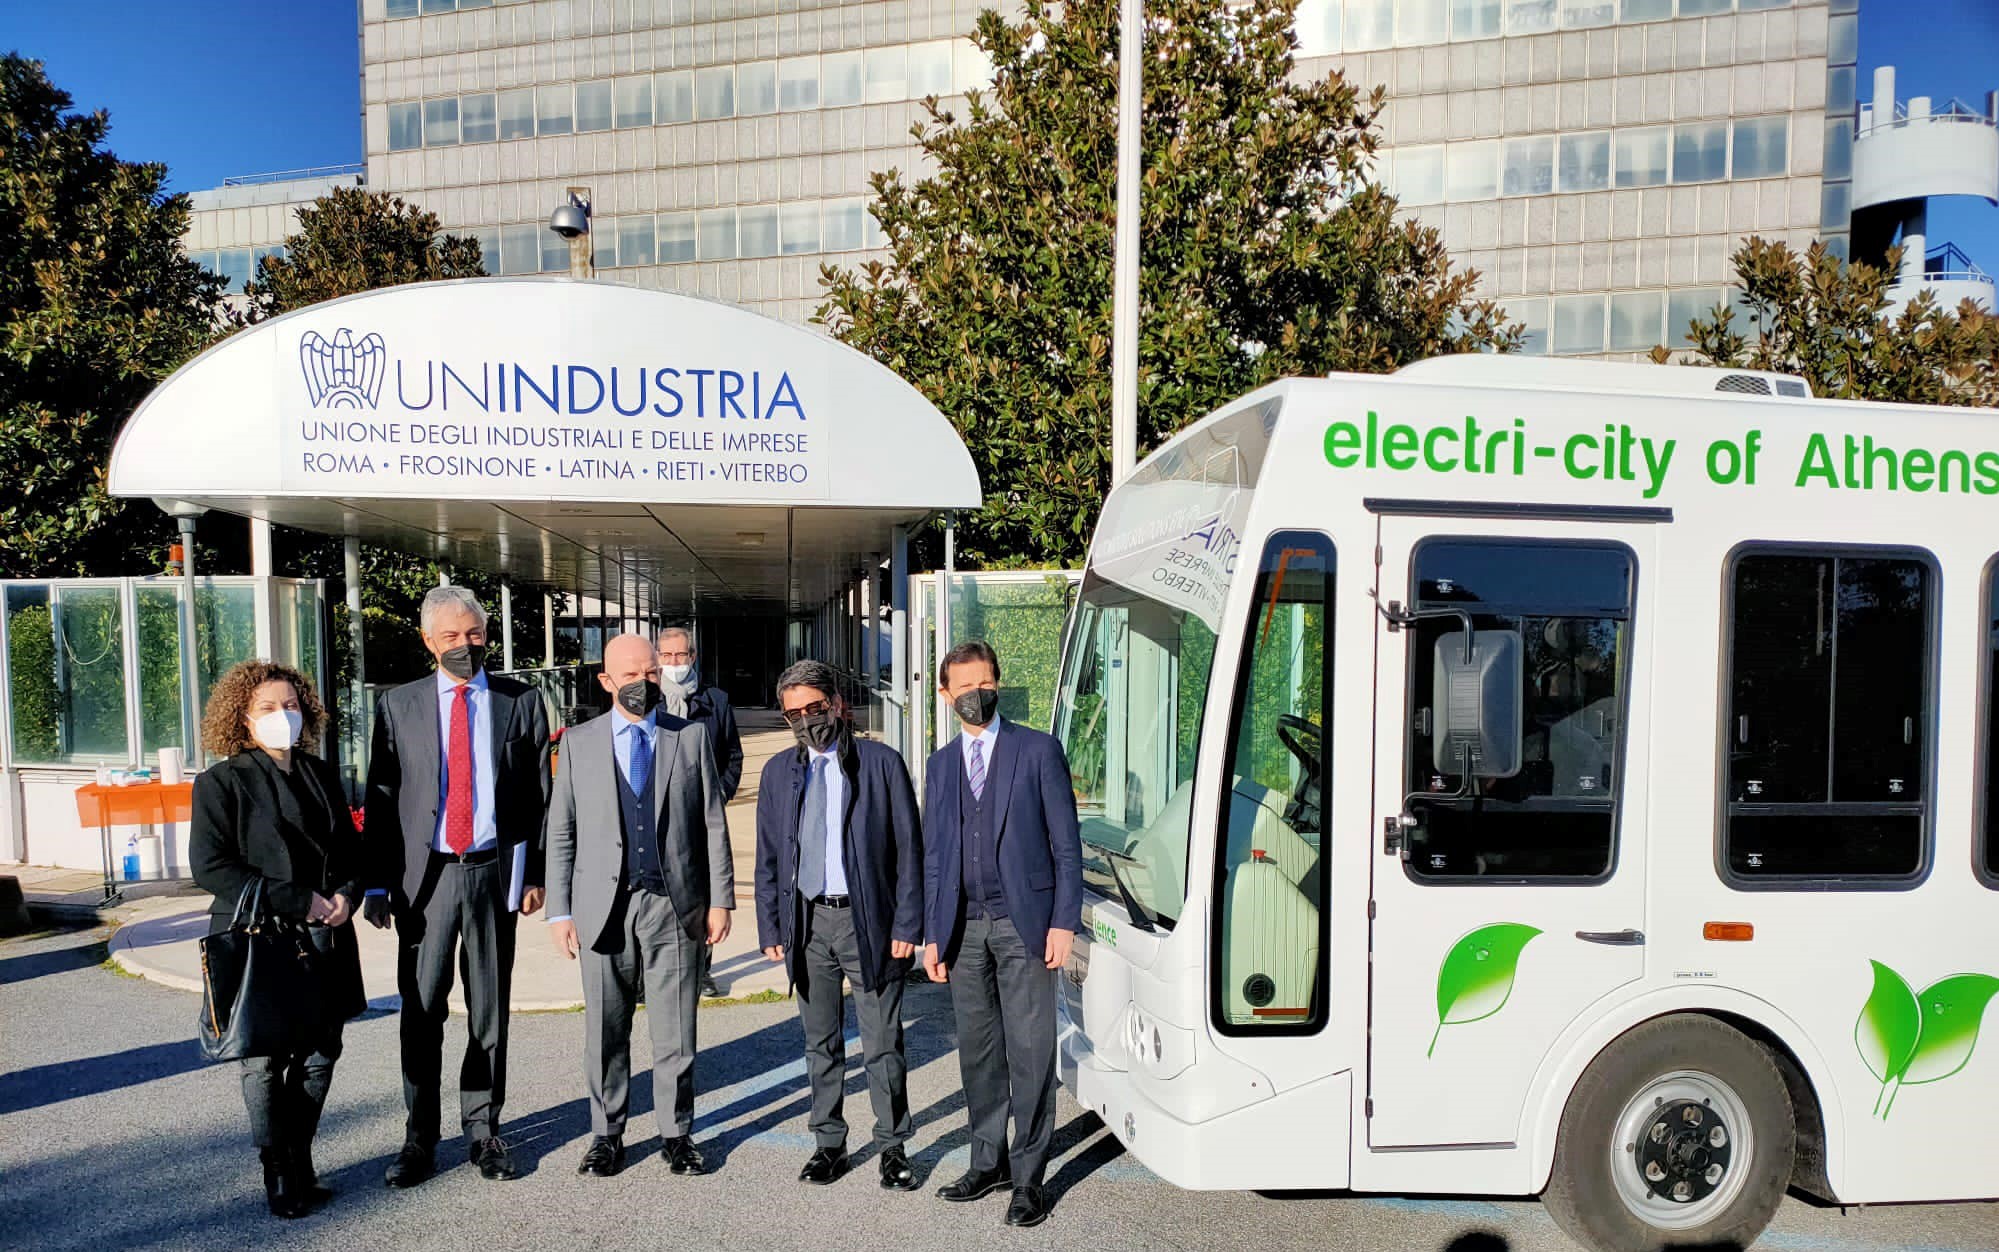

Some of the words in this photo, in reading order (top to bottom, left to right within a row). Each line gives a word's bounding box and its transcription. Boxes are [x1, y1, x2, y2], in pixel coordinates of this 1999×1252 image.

[397, 359, 807, 421] UNINDUSTRIA
[302, 421, 401, 443] UNIONE
[410, 423, 478, 446] DEGLI
[487, 426, 623, 449] INDUSTRIALI
[632, 429, 643, 449] E
[651, 430, 714, 451] DELLE
[722, 431, 809, 453] IMPRESE
[1323, 411, 1676, 499] electri-city
[1706, 429, 1761, 485] of
[1795, 433, 1999, 495] Athens
[303, 452, 376, 474] ROMA
[400, 455, 537, 478] FROSINONE
[559, 458, 635, 480] LATINA
[657, 460, 704, 481] RIETI
[719, 462, 808, 484] VITERBO
